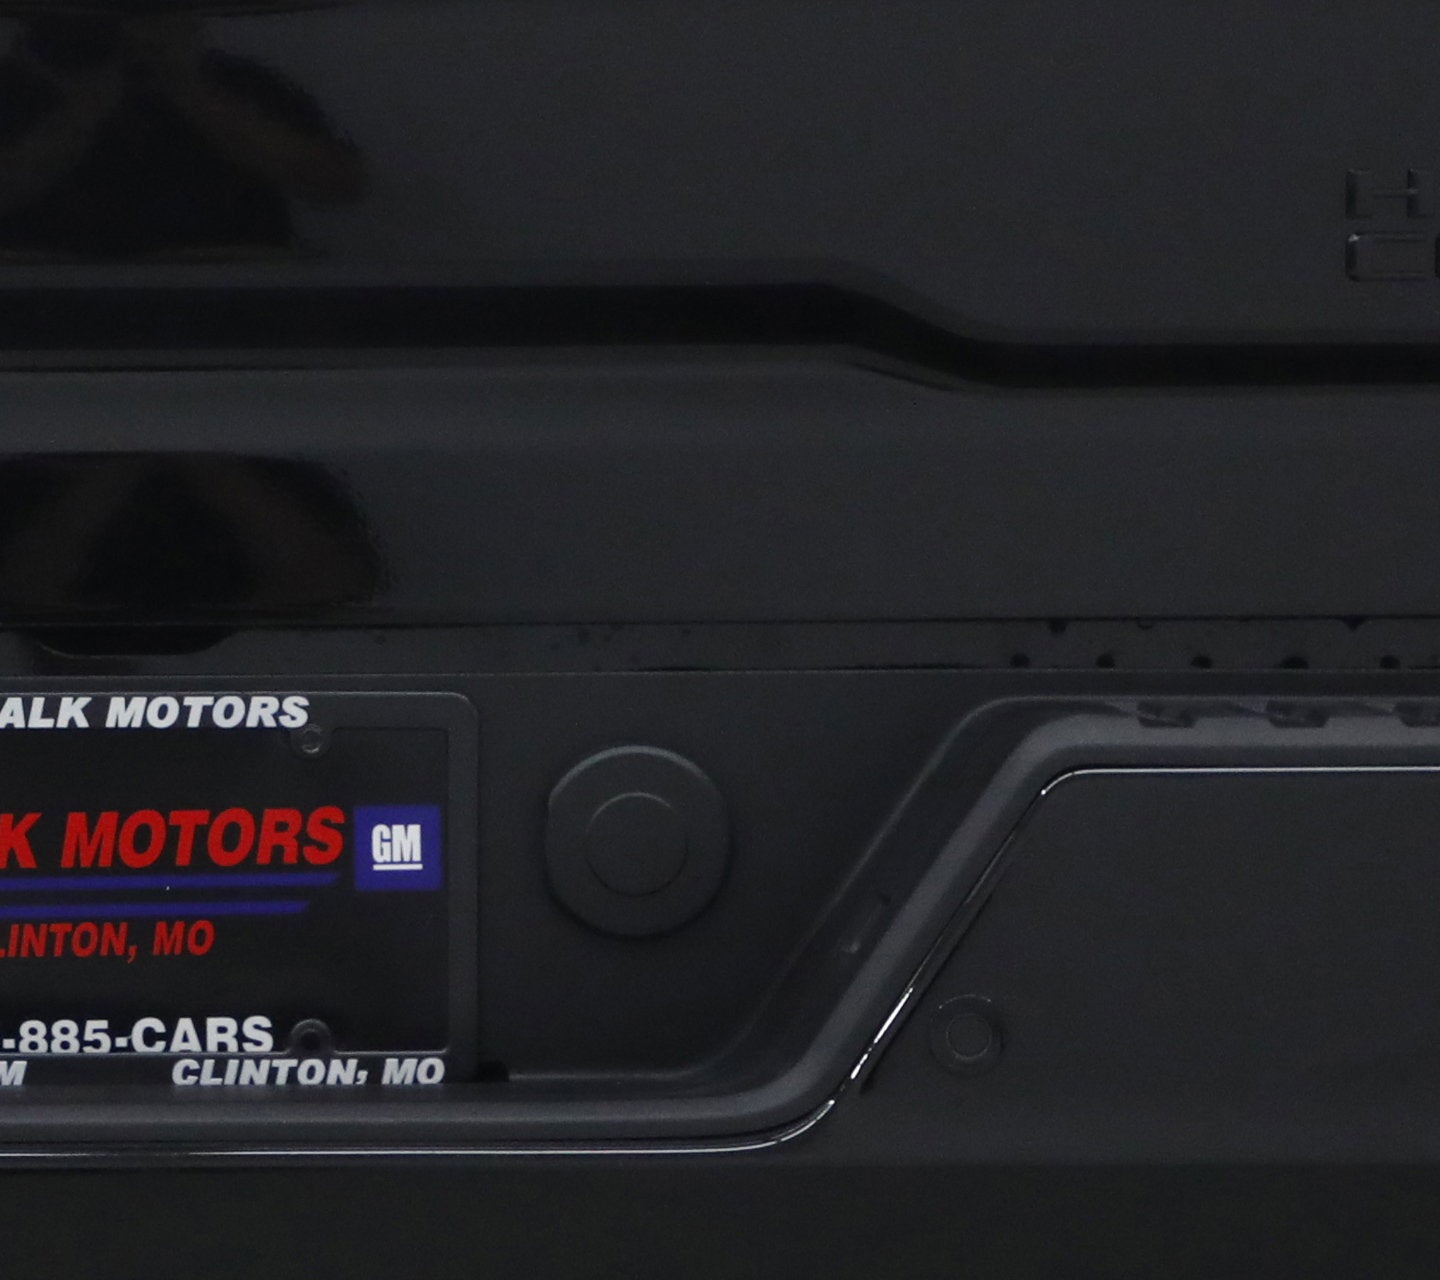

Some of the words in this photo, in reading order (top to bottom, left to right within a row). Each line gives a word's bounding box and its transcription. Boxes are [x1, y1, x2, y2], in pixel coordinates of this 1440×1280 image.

[104, 694, 310, 729] MOTORS
[59, 805, 346, 869] MOTORS
[371, 823, 423, 864] GM
[151, 920, 216, 956] MO
[171, 1058, 370, 1086] CLINTON,
[381, 1057, 446, 1086] MO
